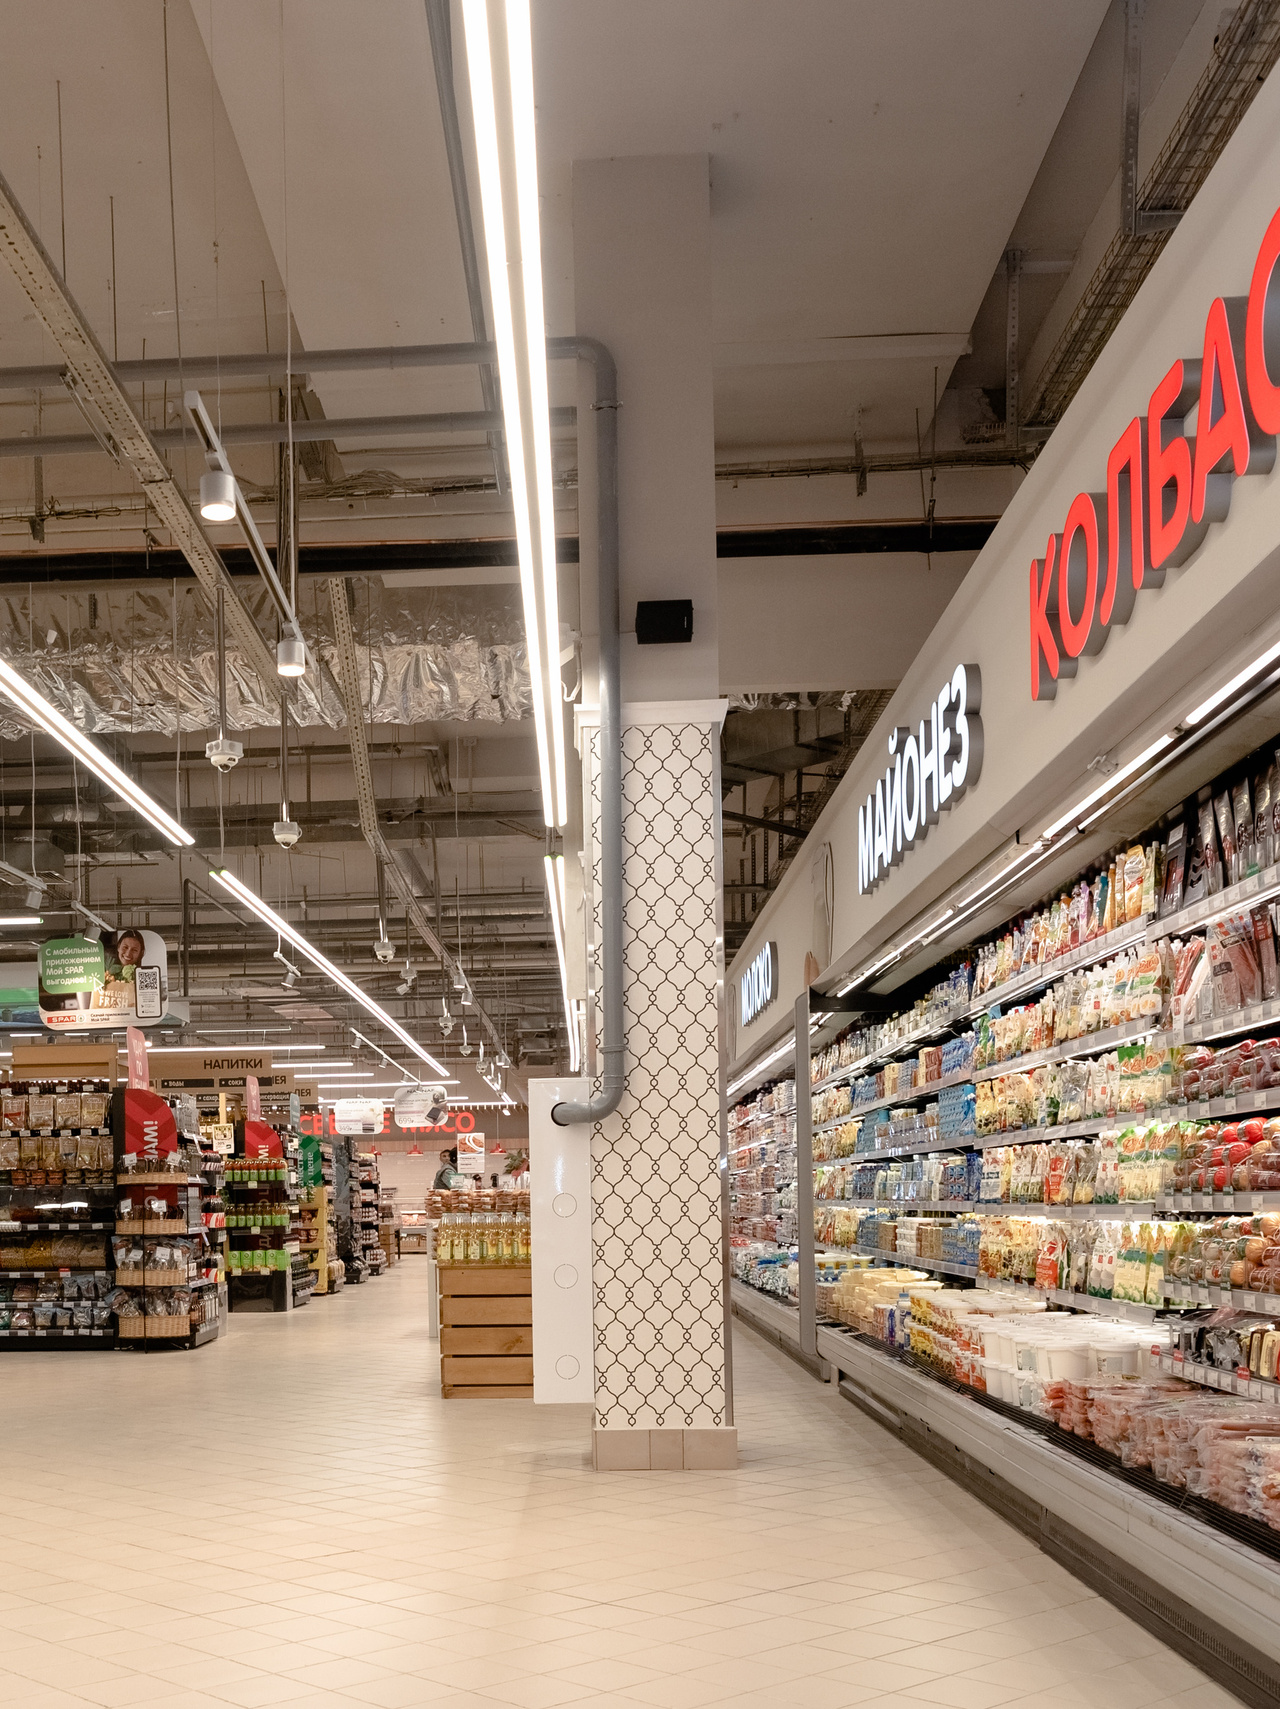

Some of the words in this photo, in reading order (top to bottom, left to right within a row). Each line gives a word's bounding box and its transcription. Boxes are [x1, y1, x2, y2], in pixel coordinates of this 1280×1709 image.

[858, 663, 970, 895] МАЙОНЕЗ
[45, 948, 52, 956] С
[53, 946, 99, 956] мобильным
[45, 956, 101, 967] приложением
[46, 967, 63, 976] Мой
[65, 966, 84, 974] SPAR
[46, 976, 87, 986] выгоднее!
[742, 941, 771, 1027] МОЛОКО
[203, 1058, 263, 1070] НАПИТКИ
